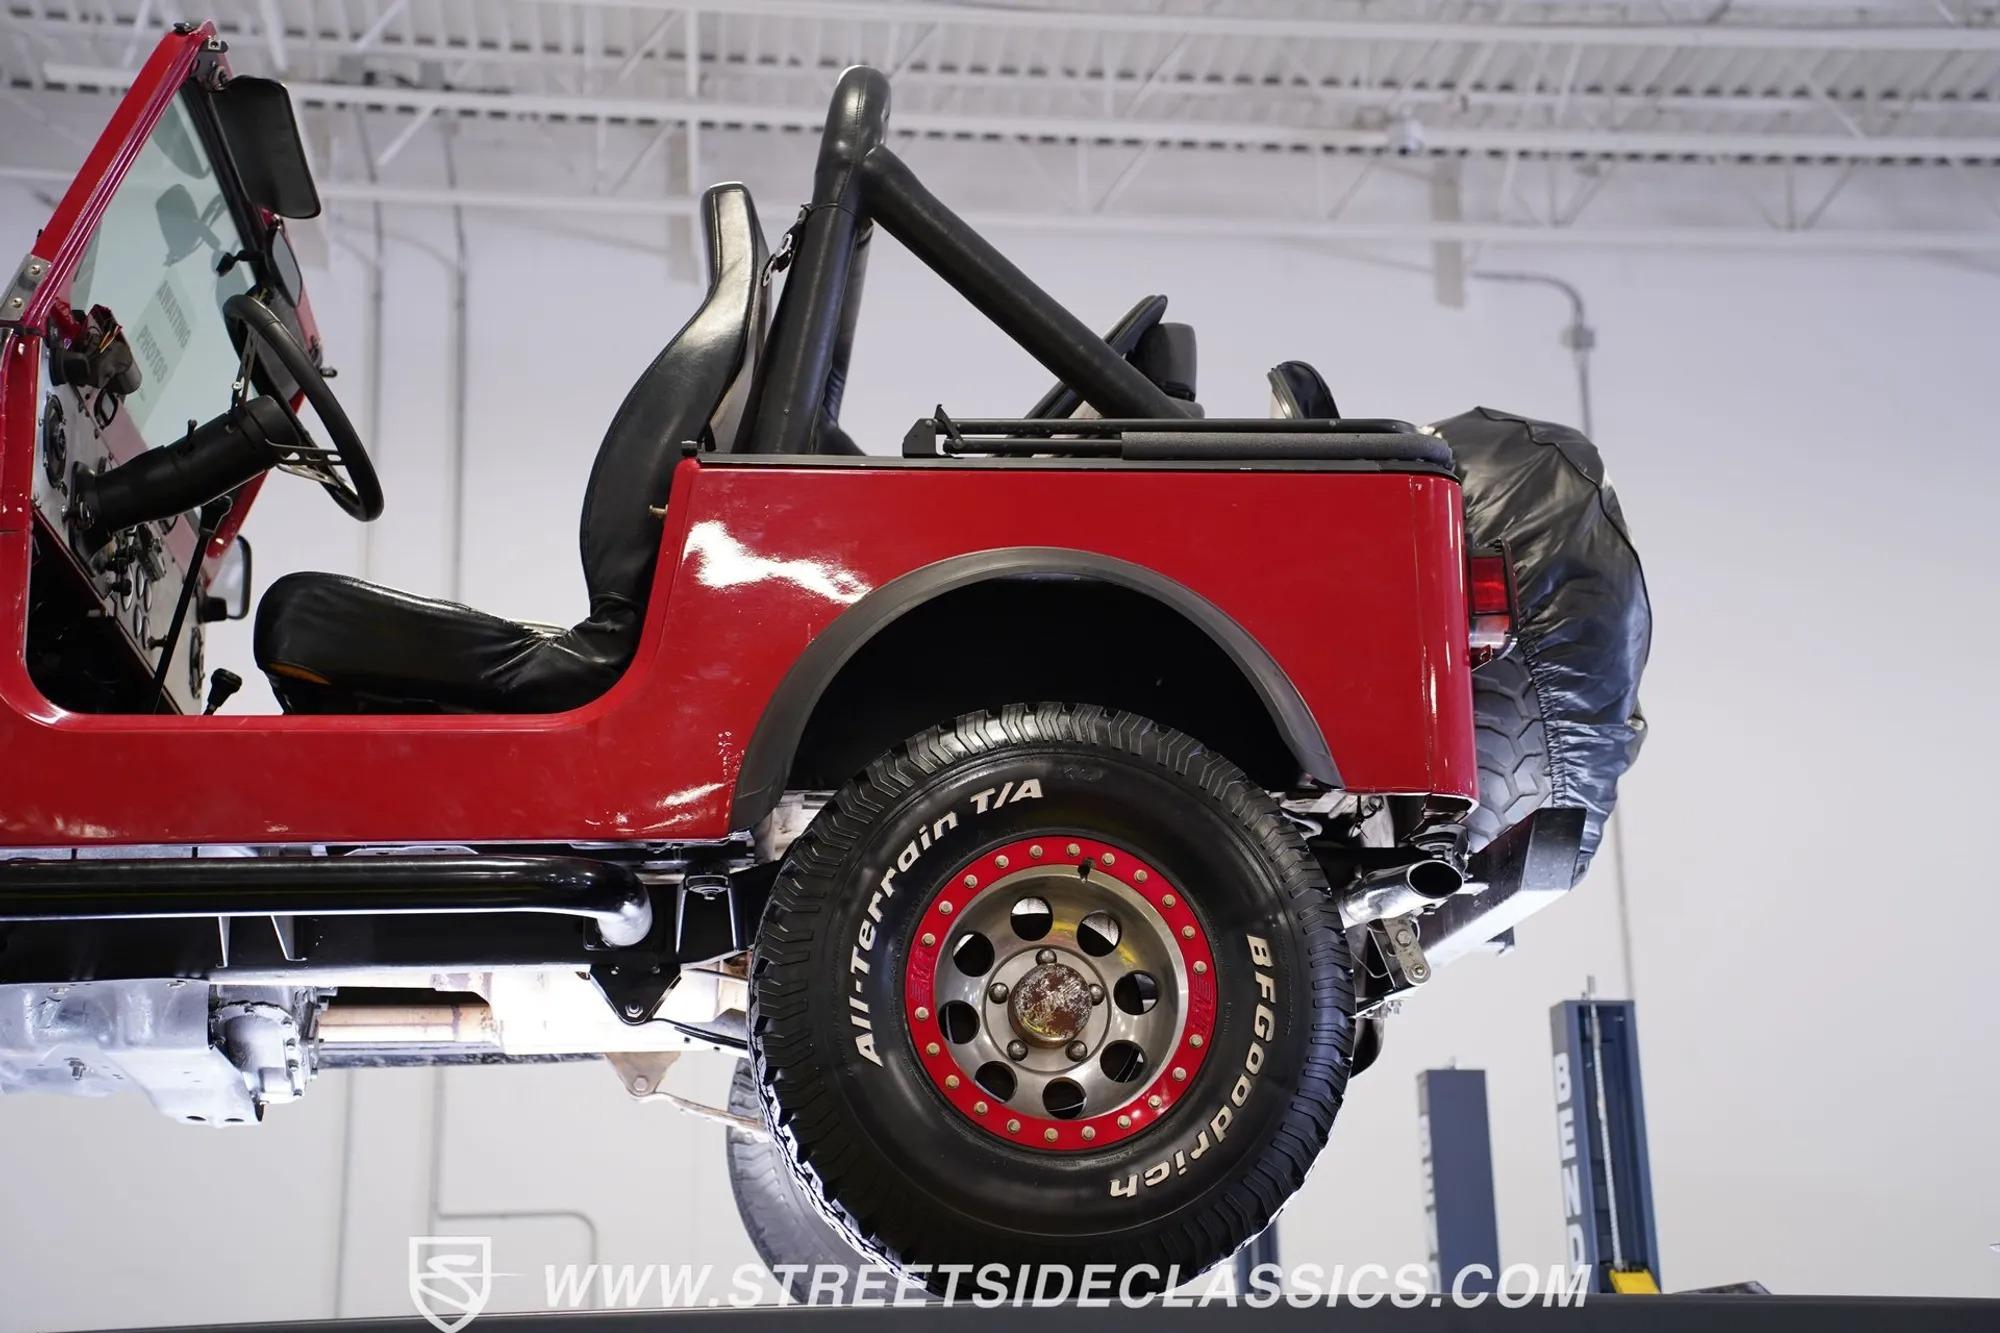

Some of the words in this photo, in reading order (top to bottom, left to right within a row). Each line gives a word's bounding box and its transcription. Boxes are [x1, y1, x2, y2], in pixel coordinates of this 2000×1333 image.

[137, 324, 168, 383] PHOTOS
[849, 810, 958, 1067] All-Terrain
[970, 778, 1044, 814] T/A
[1110, 934, 1276, 1198] BFGoodrich
